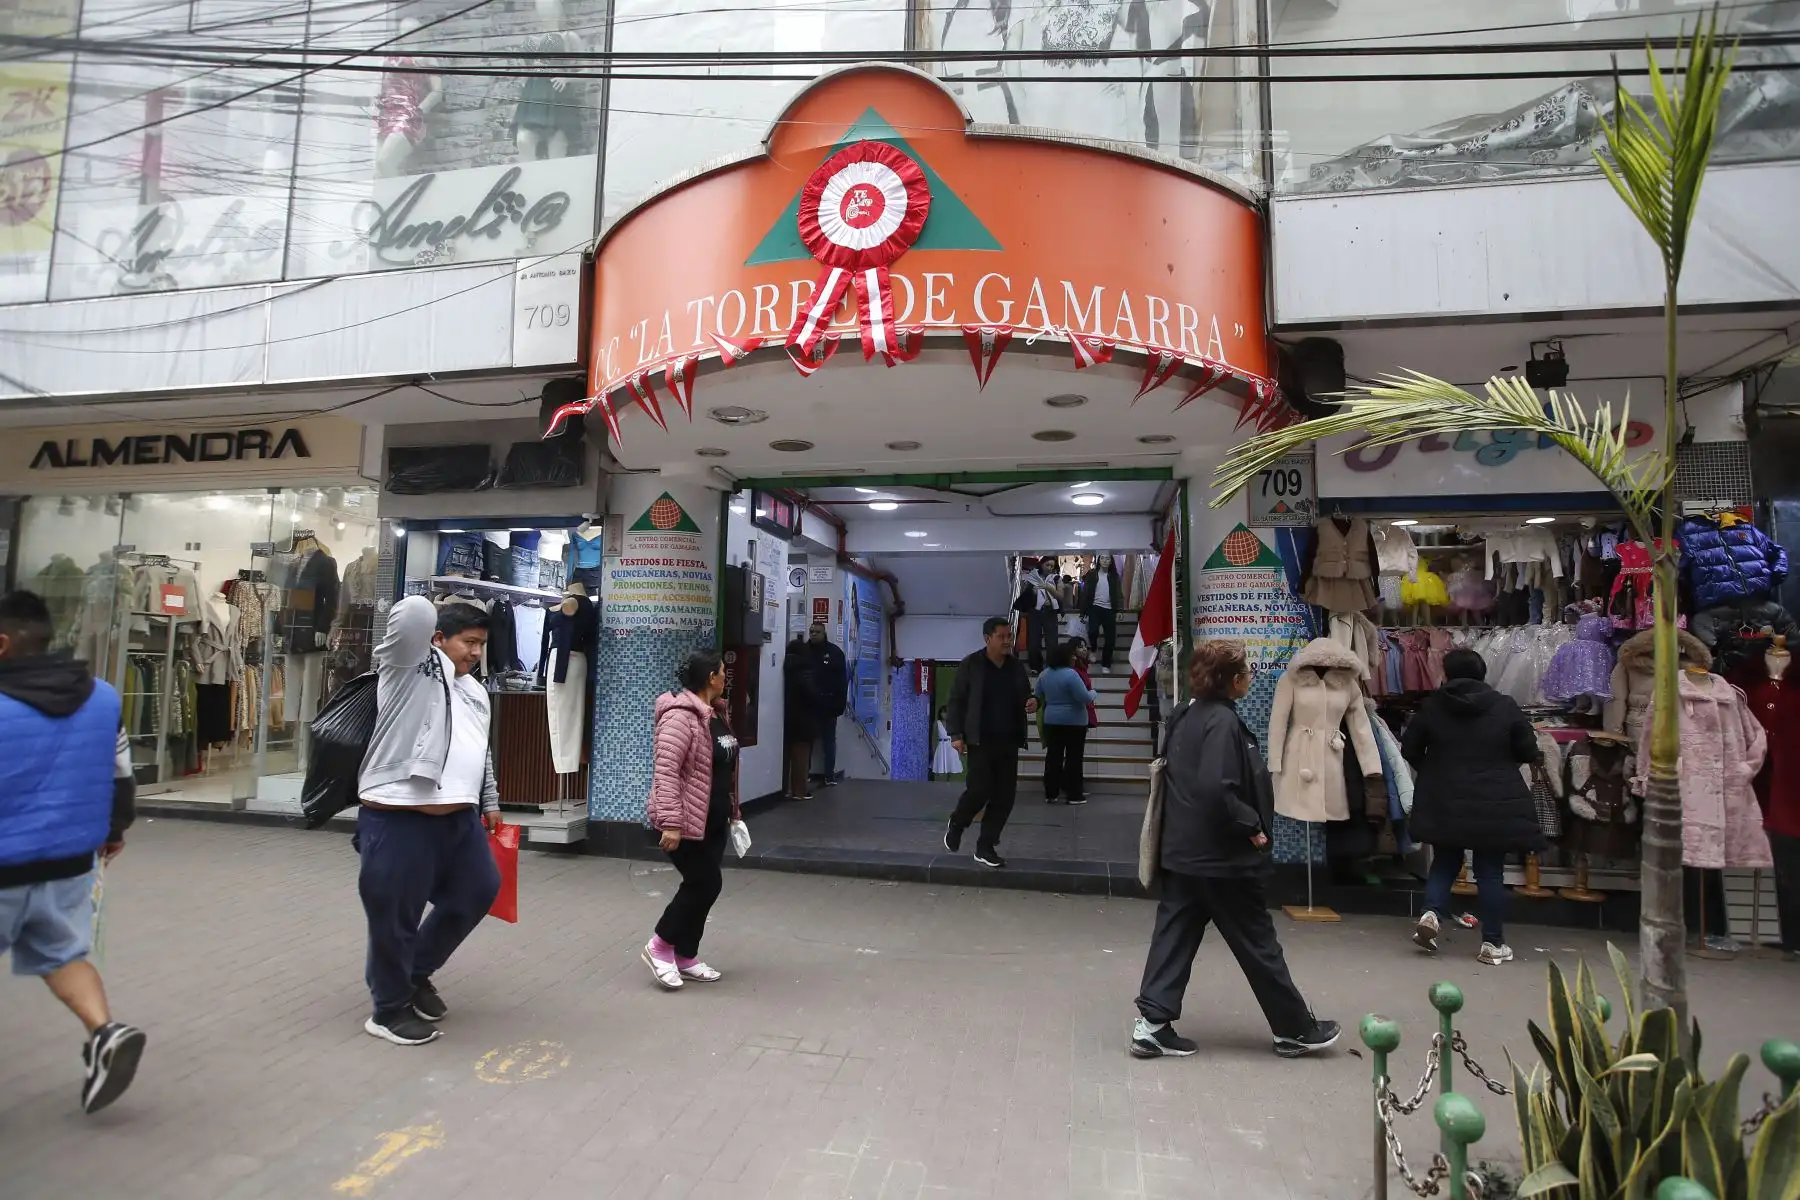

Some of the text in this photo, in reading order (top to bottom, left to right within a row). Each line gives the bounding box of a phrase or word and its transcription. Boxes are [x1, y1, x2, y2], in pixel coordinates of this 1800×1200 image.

[523, 304, 571, 329] 709
[28, 428, 311, 469] ALMENDRA
[1258, 469, 1302, 498] 709
[620, 558, 707, 570] VESTIDOS DE FIESTA,
[611, 568, 680, 579] QUINCEAÑERAS,
[613, 581, 711, 593] PROMOCIONES, TERNOS,
[1197, 592, 1238, 602] VESTIDOS
[1240, 592, 1255, 600] DE
[606, 603, 652, 613] CALZADOS,
[1193, 602, 1262, 615] QUINCEAÑERAS,
[606, 616, 623, 625] SPA,
[1194, 615, 1305, 626] PROMOCIONES, TERNOS,
[1209, 627, 1240, 636] SPORT,
